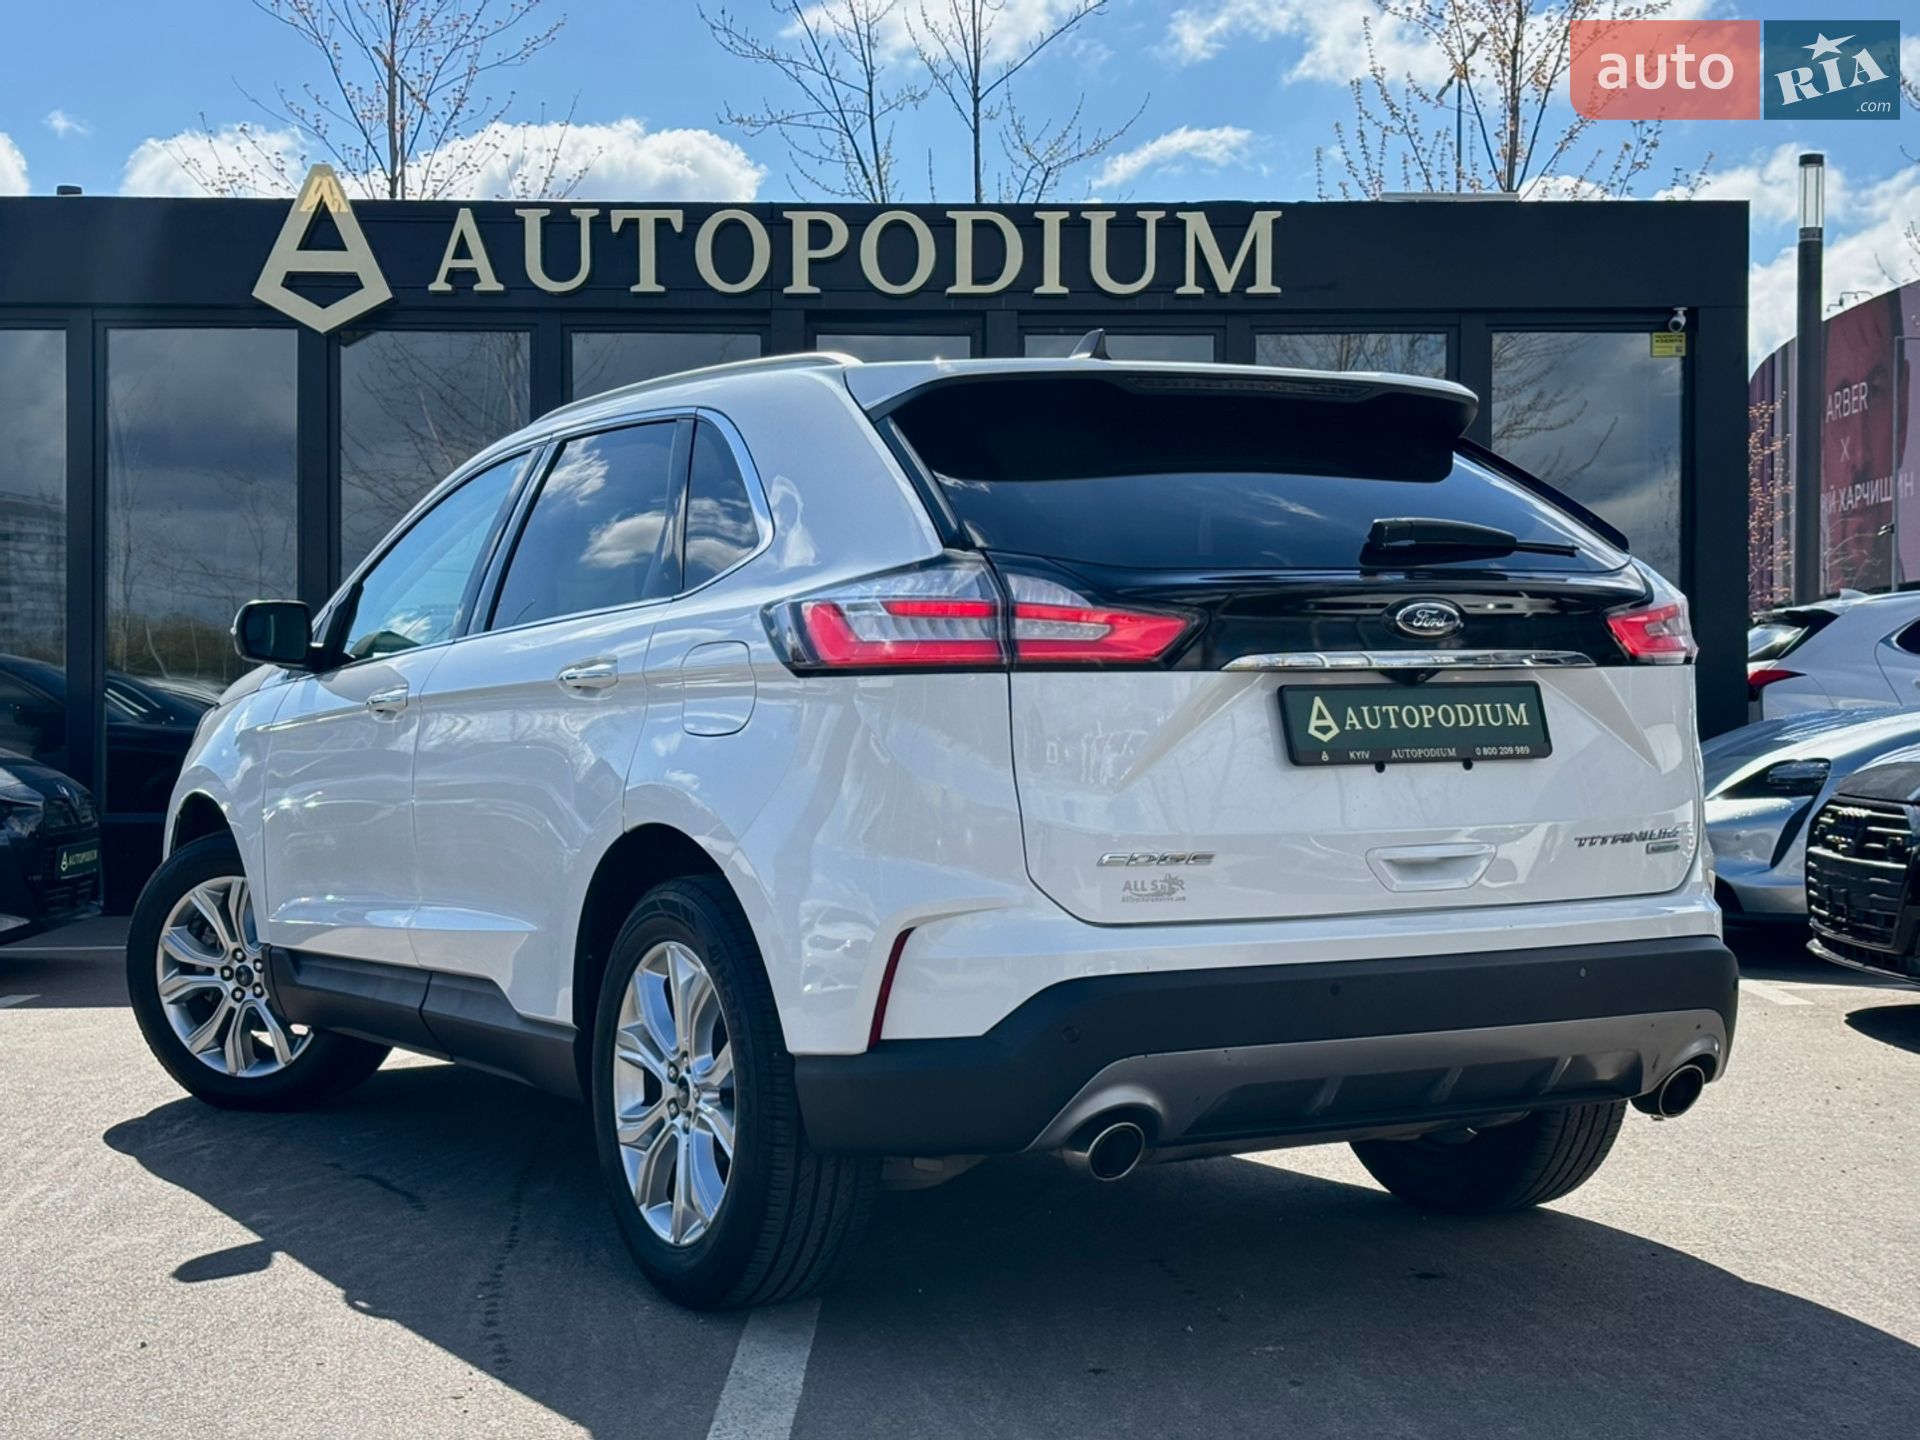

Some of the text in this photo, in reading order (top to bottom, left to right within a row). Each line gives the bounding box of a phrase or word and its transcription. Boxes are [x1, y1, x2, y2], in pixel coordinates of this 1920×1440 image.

[428, 208, 1282, 295] AUTOPODIUM
[1825, 381, 1868, 424] ARBER
[1412, 608, 1448, 628] Ford
[1344, 703, 1530, 730] AUTOPODIUM
[1349, 750, 1370, 760] KYIV
[1391, 747, 1456, 759] AUTOPODIUM
[1096, 852, 1216, 867] EDGE
[1122, 880, 1147, 892] ALL
